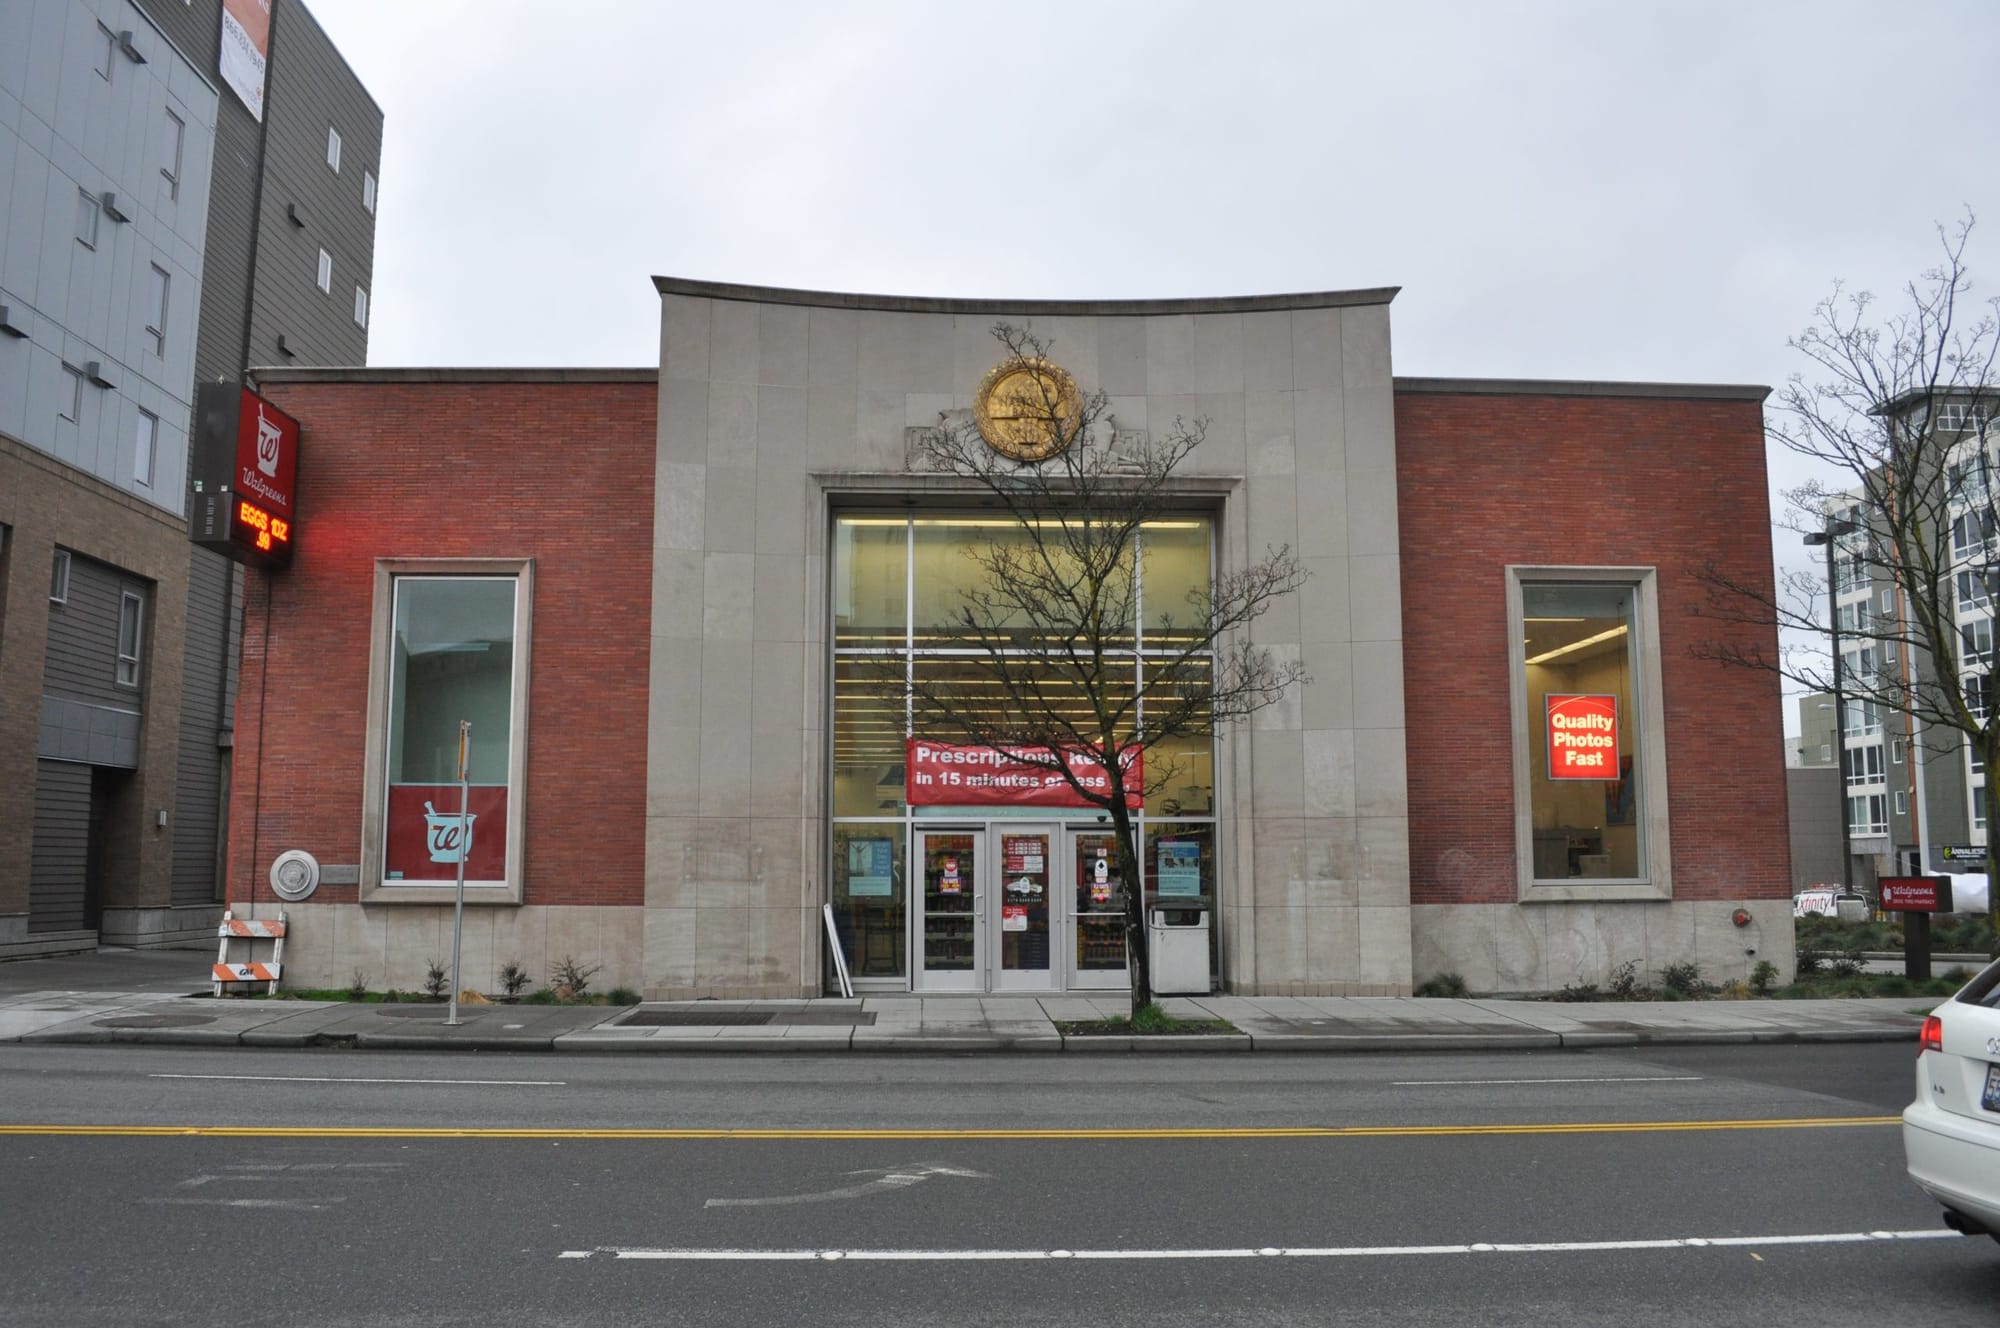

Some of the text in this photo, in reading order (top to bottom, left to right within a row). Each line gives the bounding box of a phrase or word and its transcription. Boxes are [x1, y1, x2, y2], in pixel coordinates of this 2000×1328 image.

[242, 466, 287, 506] Walgreens
[241, 503, 268, 531] EGGS
[256, 530, 270, 551] .99
[1552, 713, 1614, 732] Quality
[1553, 732, 1614, 748] Photos
[916, 746, 1135, 770] Prescriptions Rey
[1565, 751, 1604, 766] Fast
[916, 771, 1106, 788] in 15 minutes or ess
[1892, 886, 1935, 898] Walgreens
[1799, 895, 1831, 914] xfinity
